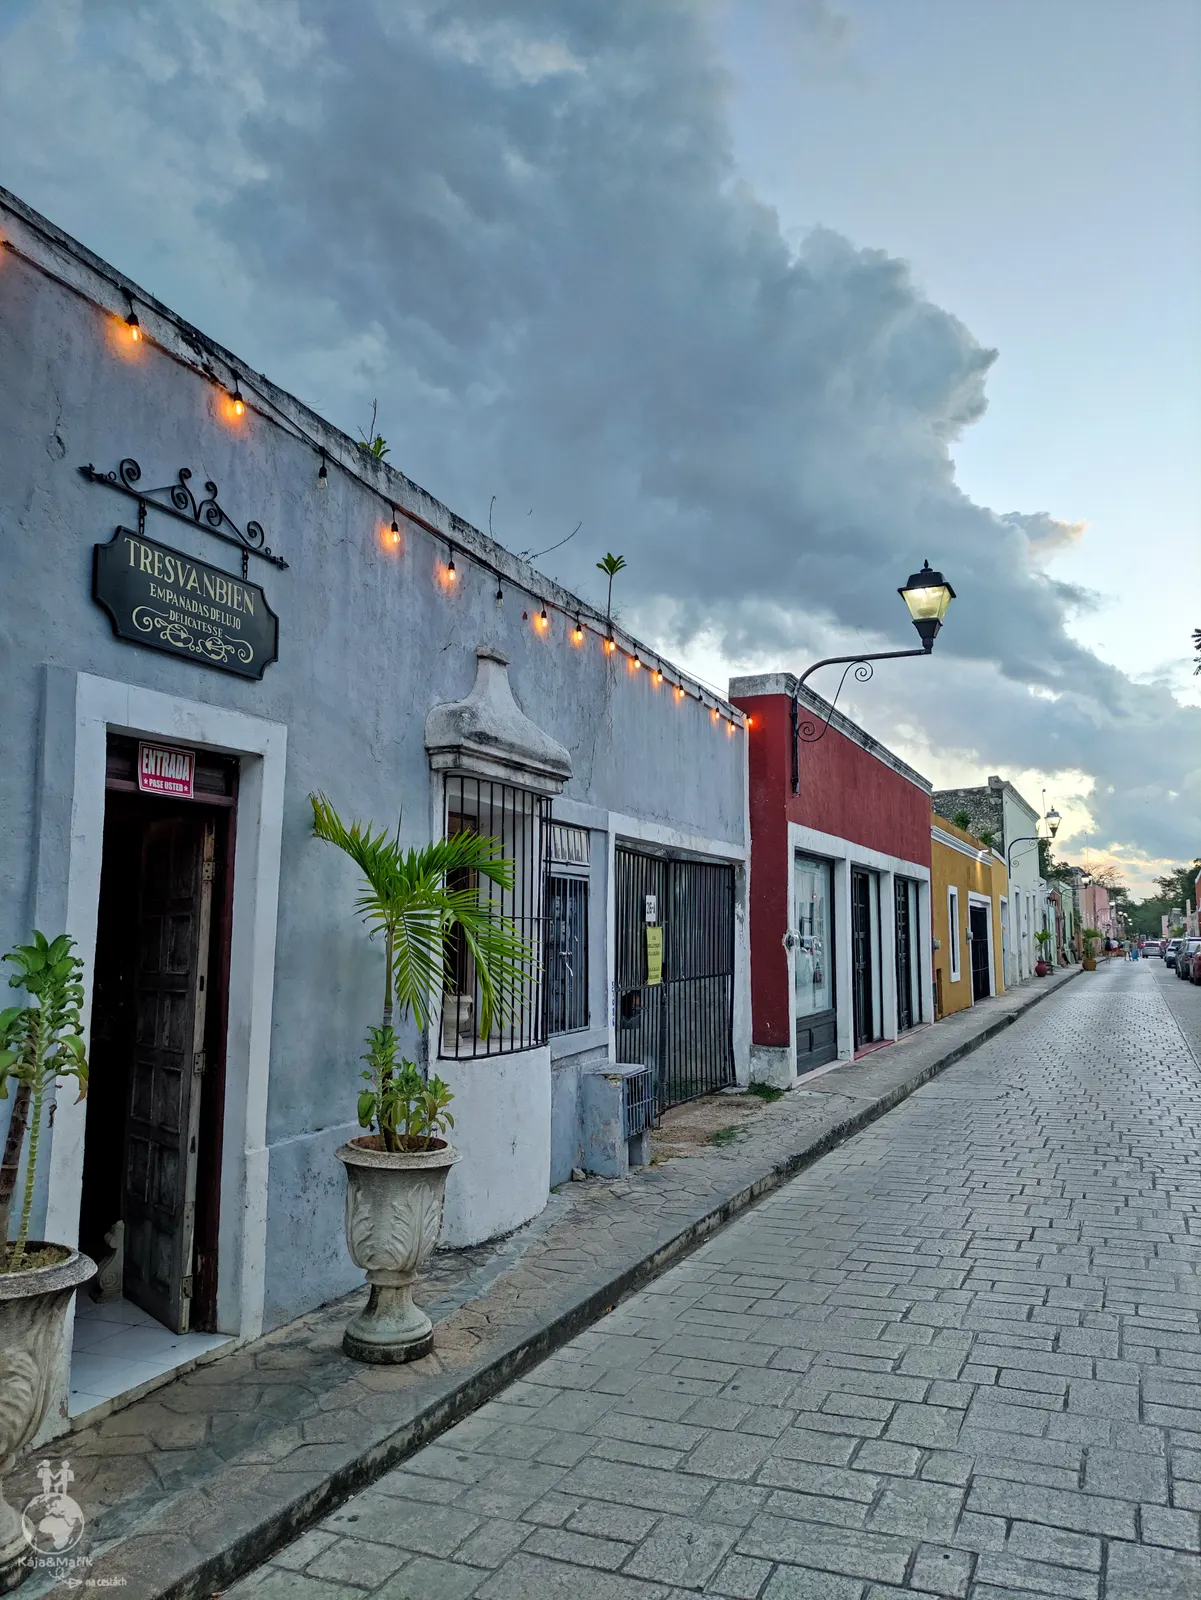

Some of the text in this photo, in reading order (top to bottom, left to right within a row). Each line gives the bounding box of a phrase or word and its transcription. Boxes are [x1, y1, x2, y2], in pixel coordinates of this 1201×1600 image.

[150, 582, 209, 617] EMPANADAS
[169, 609, 223, 638] DELICATESSE
[143, 748, 190, 781] ENTRADA
[149, 779, 183, 791] PASE USTED
